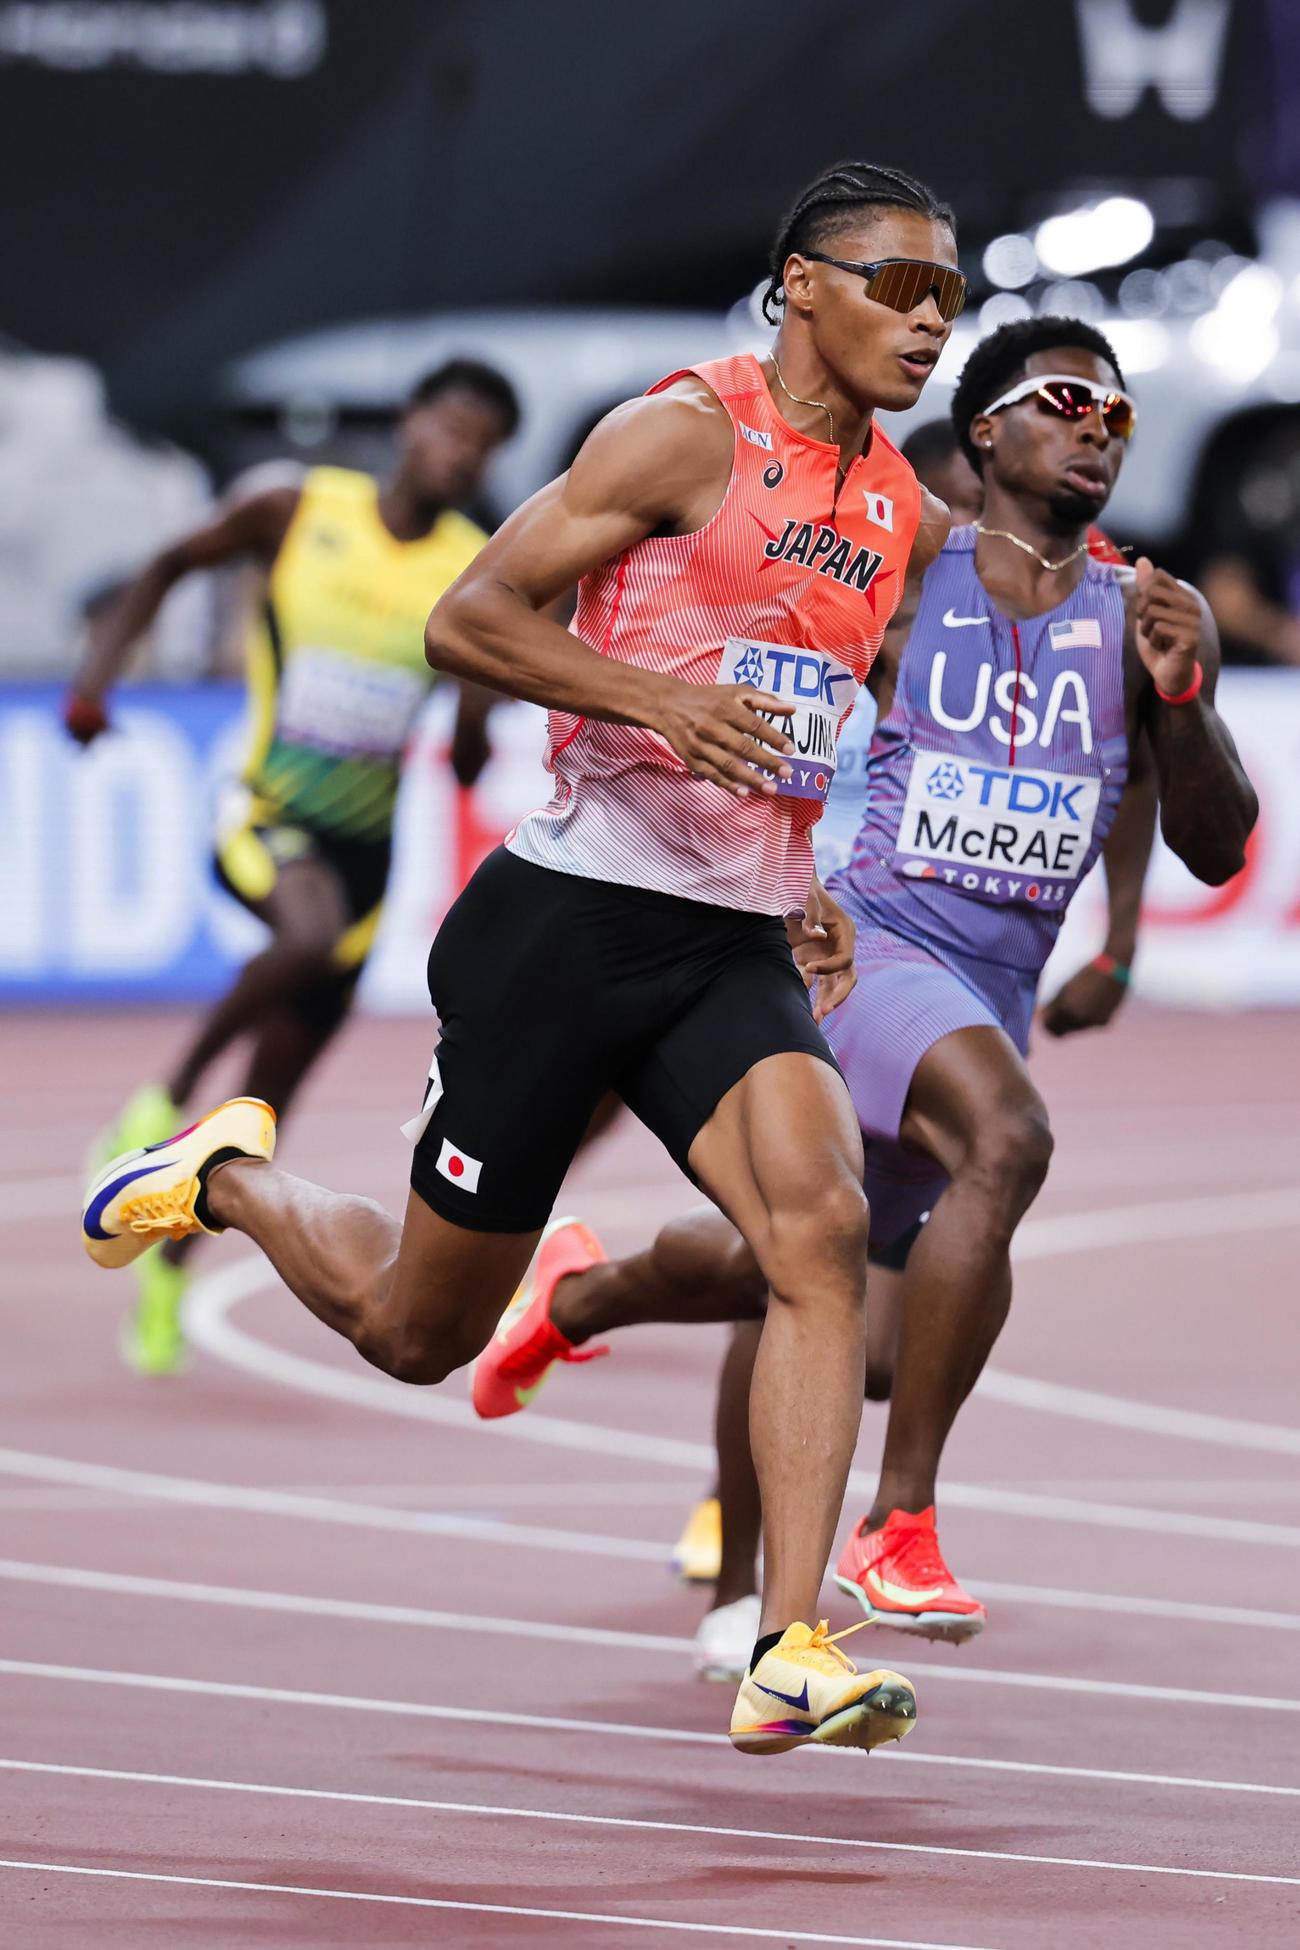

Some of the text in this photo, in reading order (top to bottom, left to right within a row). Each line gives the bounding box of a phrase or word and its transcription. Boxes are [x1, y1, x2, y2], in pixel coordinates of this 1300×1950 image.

[765, 519, 884, 593] JAPAN
[766, 650, 853, 706] TDK
[929, 651, 1093, 754] USA
[968, 767, 1085, 821] TDK
[914, 810, 1080, 871] McRAE
